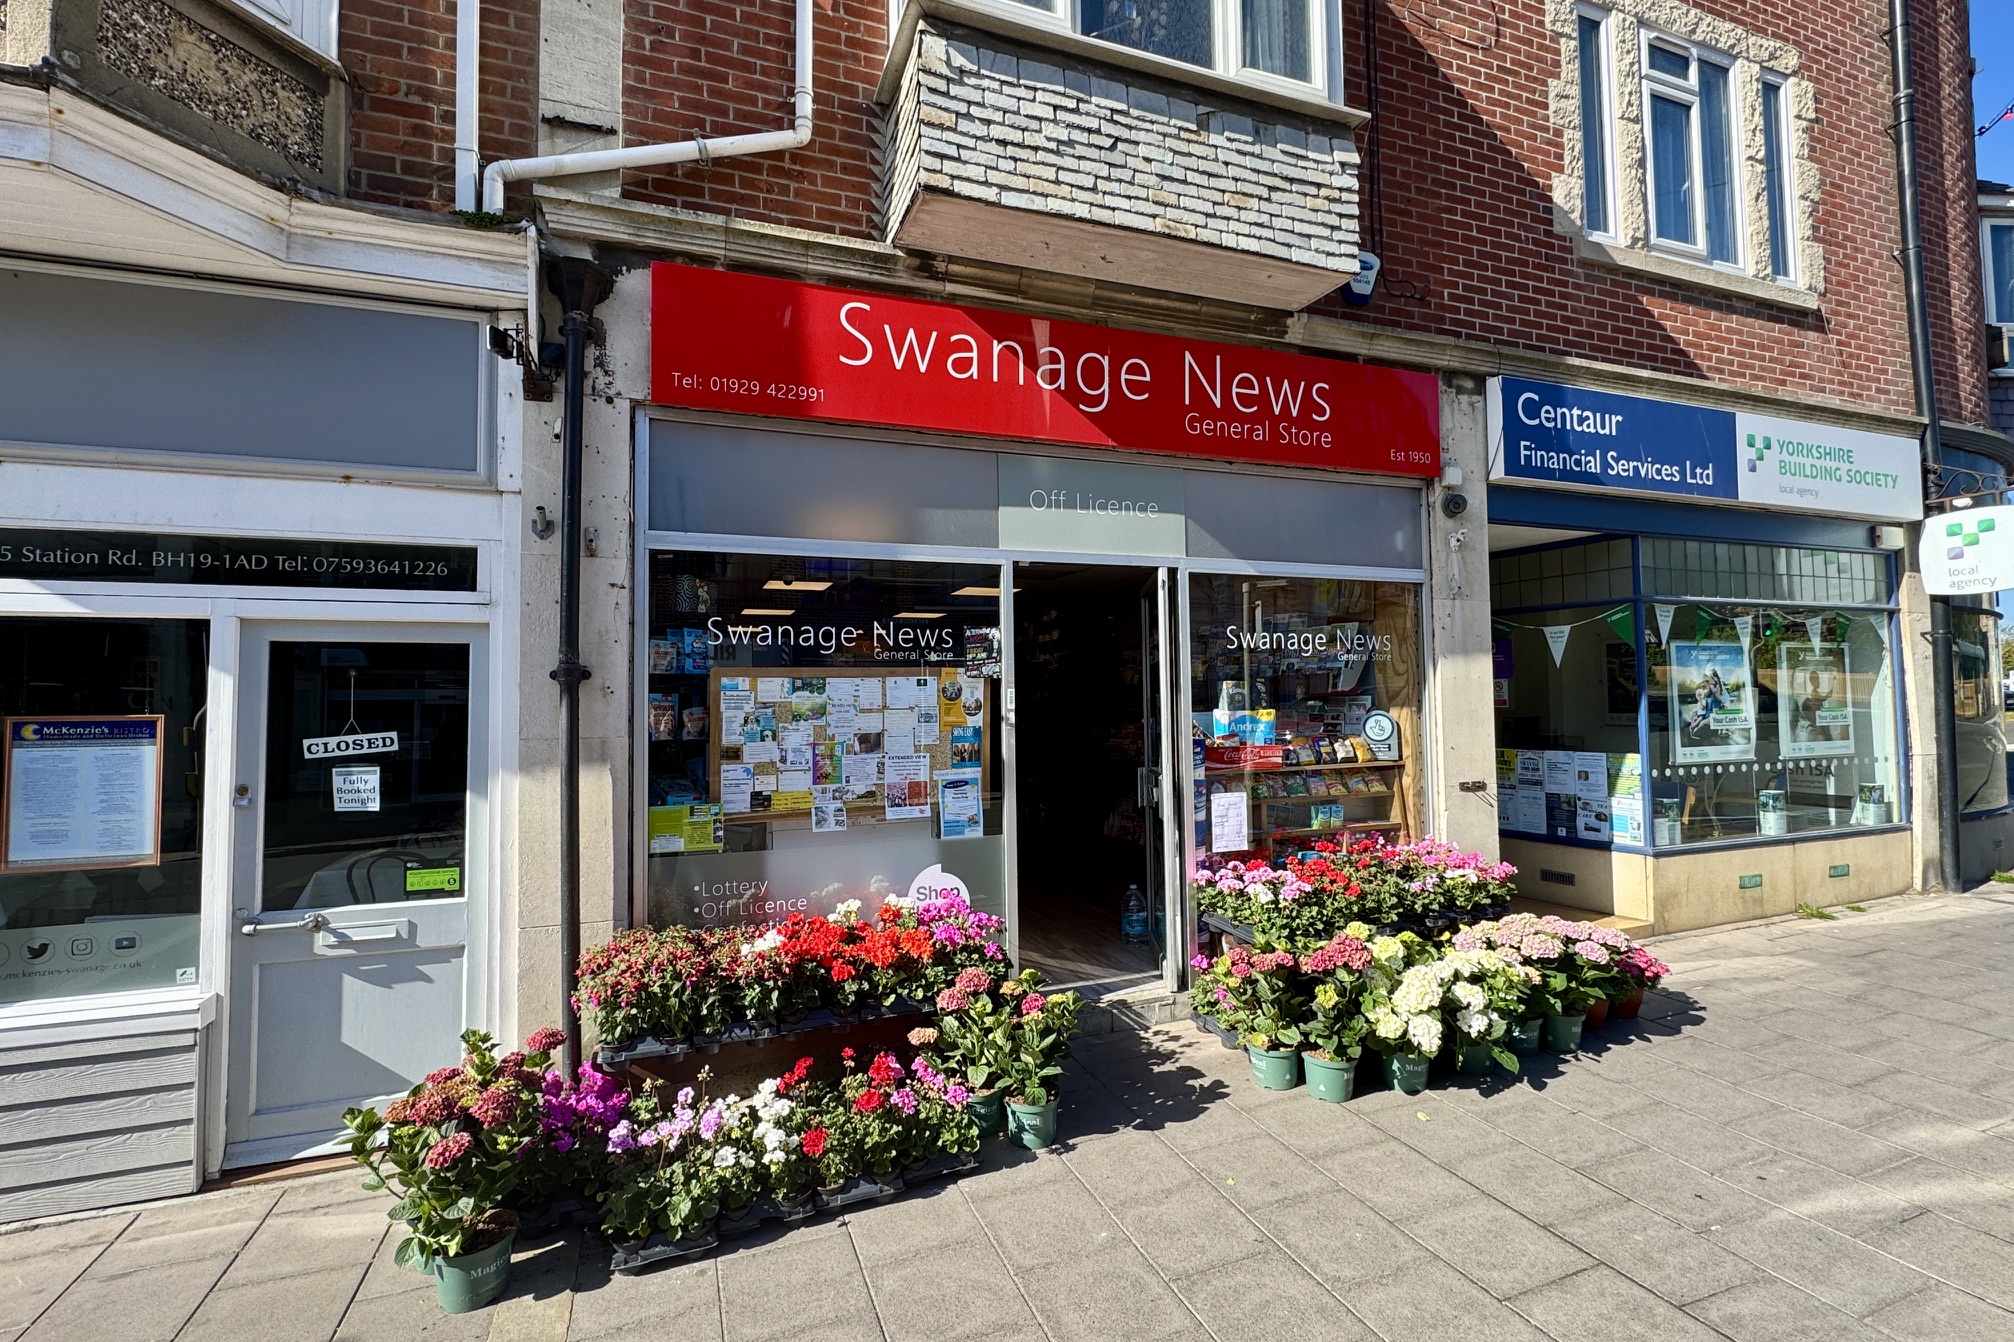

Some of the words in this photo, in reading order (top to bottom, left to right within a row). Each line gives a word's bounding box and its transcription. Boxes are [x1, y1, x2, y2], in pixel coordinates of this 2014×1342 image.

[839, 302, 1151, 413] Swanage
[1185, 350, 1331, 422] News
[671, 372, 703, 389] Tel:
[710, 376, 760, 395] 01929
[766, 383, 825, 403] 422991
[1517, 392, 1623, 436] Centaur
[1185, 412, 1270, 442] General
[1279, 422, 1333, 448] Store
[1390, 449, 1405, 462] Est
[1408, 451, 1431, 464] 1950
[1777, 439, 1854, 465] YORKSHIRE
[1520, 440, 1600, 474] Financial
[1606, 451, 1681, 482] Services
[1686, 460, 1714, 486] Ltd
[1778, 460, 1842, 483] BUILDING
[1846, 468, 1899, 490] SOCIETY
[1779, 484, 1795, 495] local
[1796, 487, 1819, 500] agency
[1029, 489, 1067, 513] Off
[1076, 491, 1159, 518] Licence
[21, 546, 99, 564] Station
[108, 549, 143, 567] Rd.
[152, 551, 268, 571] BH19-1AD
[274, 556, 308, 571] Tel:
[313, 557, 449, 576] 07593641226
[1949, 564, 1979, 578] local
[1949, 576, 1998, 592] agency
[707, 617, 857, 654] Swanage
[874, 620, 953, 648] News
[1226, 625, 1327, 657] Swanage
[1336, 628, 1392, 651] News
[874, 649, 919, 660] General
[924, 649, 954, 660] Store
[1337, 651, 1369, 661] General
[1371, 651, 1392, 661] Store
[1230, 722, 1266, 732] Andrex
[1712, 716, 1724, 724] Your
[1724, 716, 1738, 724] Cash
[43, 726, 110, 735] McKenzie's
[306, 736, 396, 756] CLOSED
[342, 776, 369, 786] Fully
[336, 786, 376, 795] Booked
[337, 796, 377, 807] Tonight
[702, 880, 768, 898] Lottery
[915, 885, 961, 902] Shop
[701, 902, 733, 919] Off
[739, 896, 808, 916] Licence
